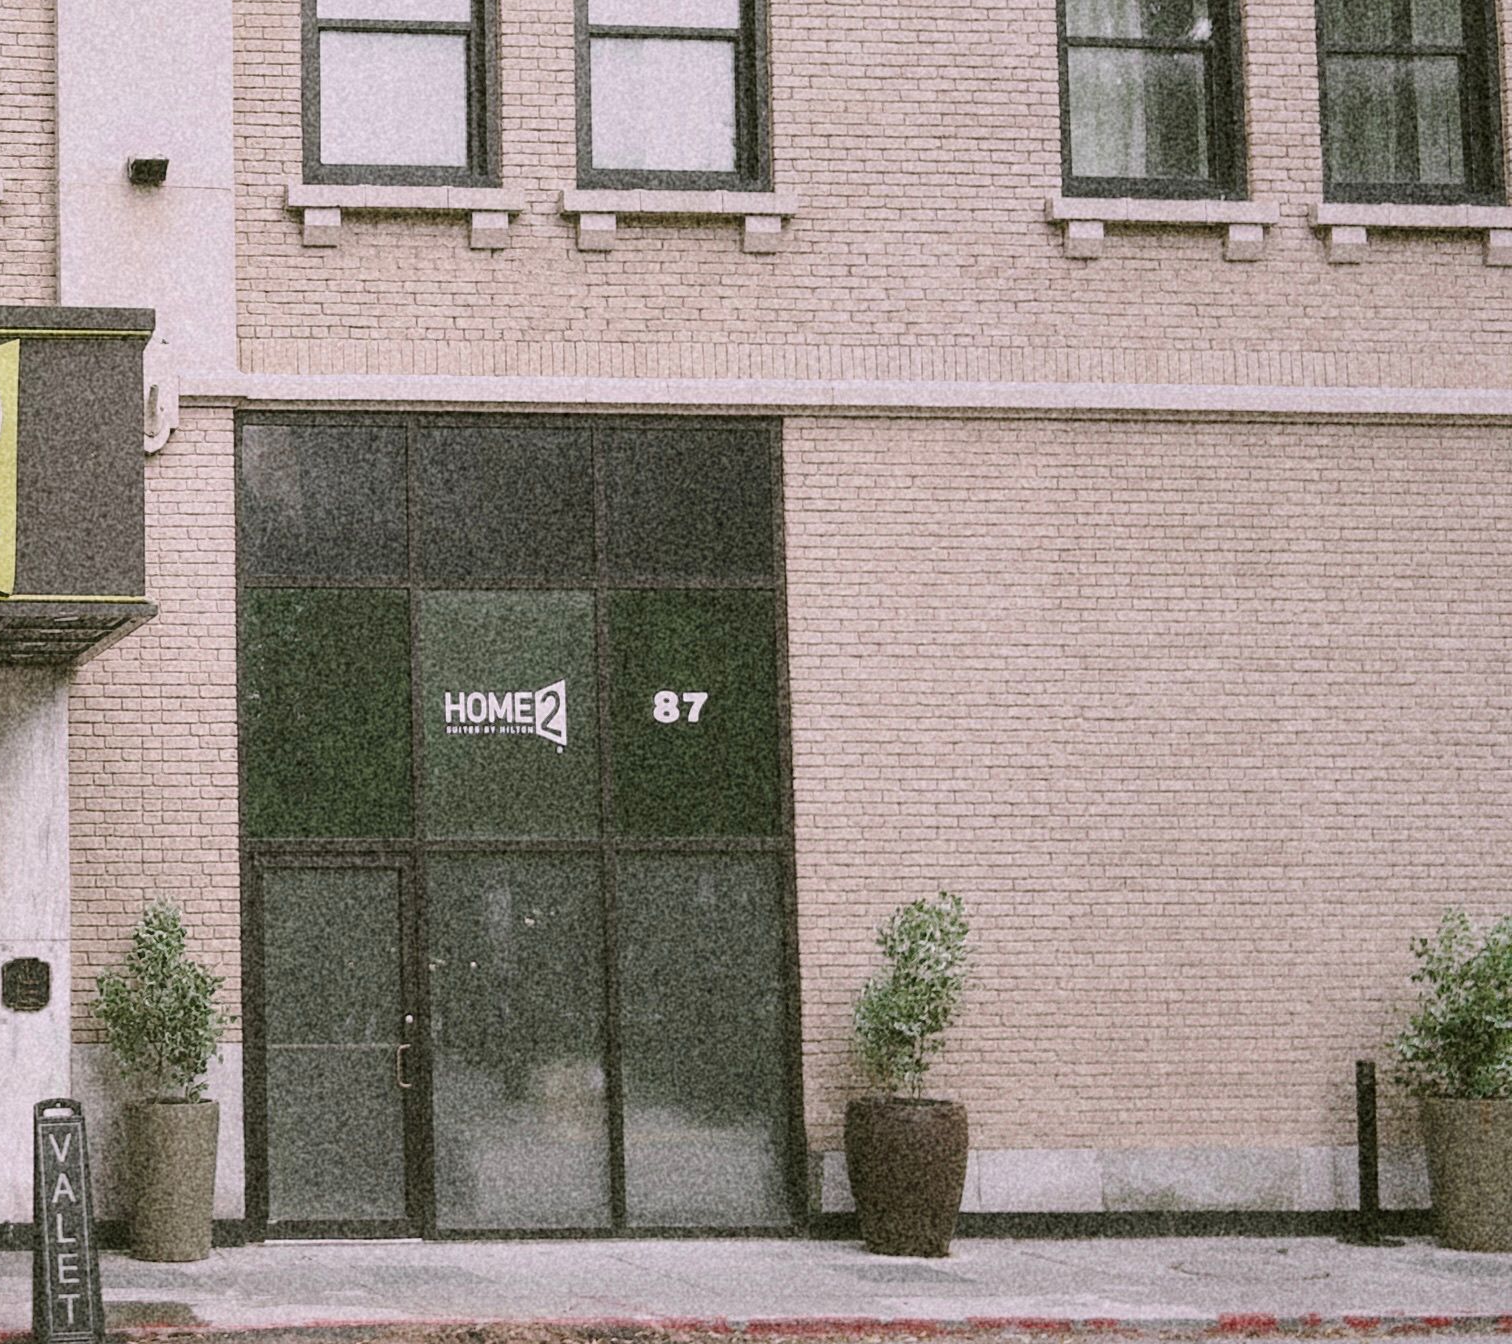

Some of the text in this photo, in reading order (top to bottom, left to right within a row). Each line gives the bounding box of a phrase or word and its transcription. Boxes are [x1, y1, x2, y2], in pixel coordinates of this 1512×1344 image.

[652, 690, 709, 724] 87
[446, 725, 480, 734] SUITES
[500, 725, 533, 734] HILTON
[48, 1132, 80, 1325] VALET
